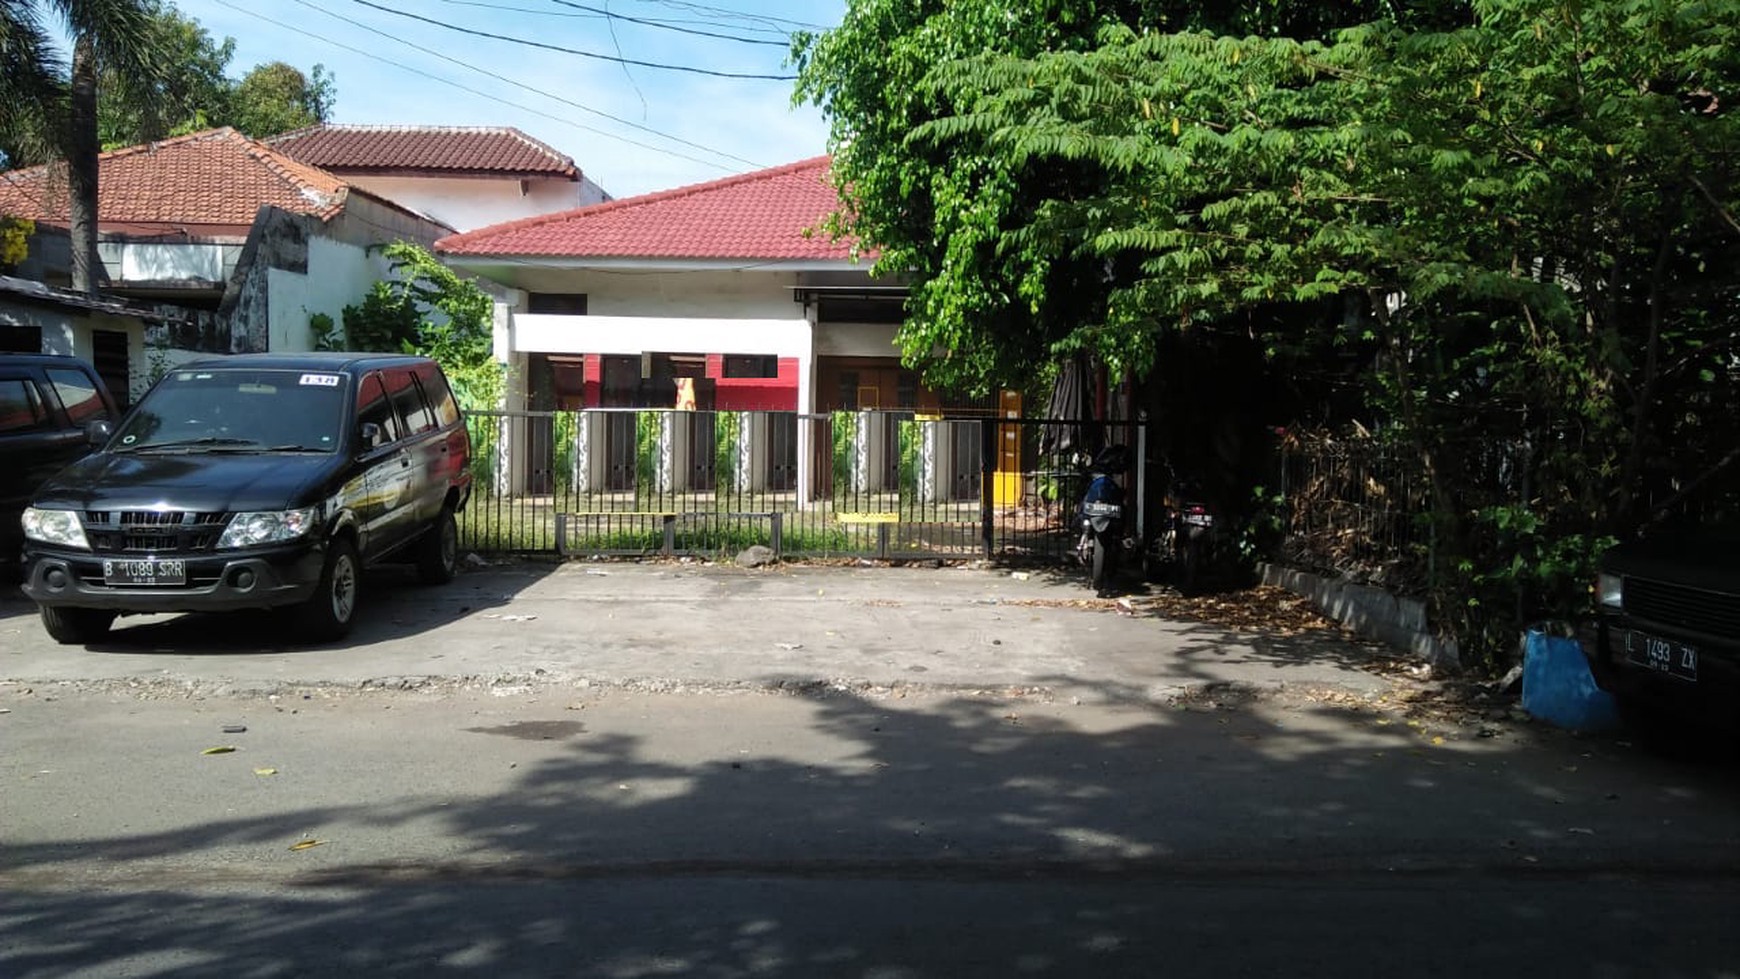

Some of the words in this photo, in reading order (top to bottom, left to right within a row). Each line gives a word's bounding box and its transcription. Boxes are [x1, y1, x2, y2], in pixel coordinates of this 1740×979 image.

[105, 562, 113, 577] B
[125, 562, 154, 577] 1089
[159, 562, 183, 577] SRR
[1628, 632, 1635, 652] L
[1646, 638, 1670, 662] 1493
[1681, 647, 1695, 670] ZX
